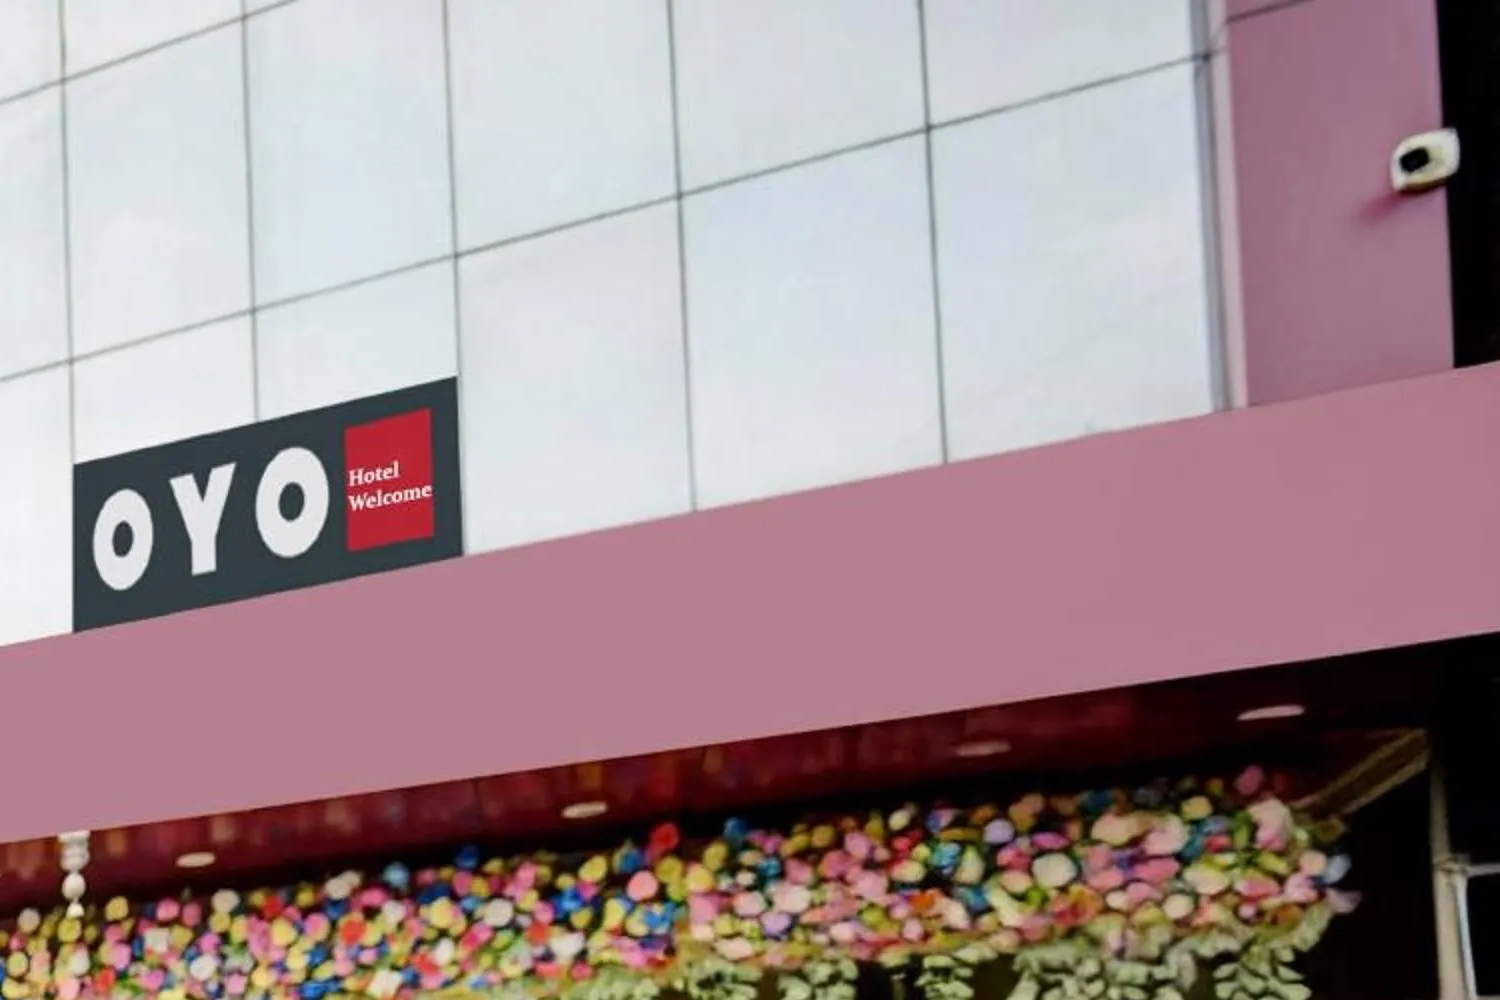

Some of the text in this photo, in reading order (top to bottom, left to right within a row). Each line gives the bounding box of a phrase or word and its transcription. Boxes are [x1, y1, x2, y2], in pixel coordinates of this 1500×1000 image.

[348, 460, 400, 487] Hotel
[348, 484, 433, 512] Welcome
[92, 446, 330, 592] OYO
